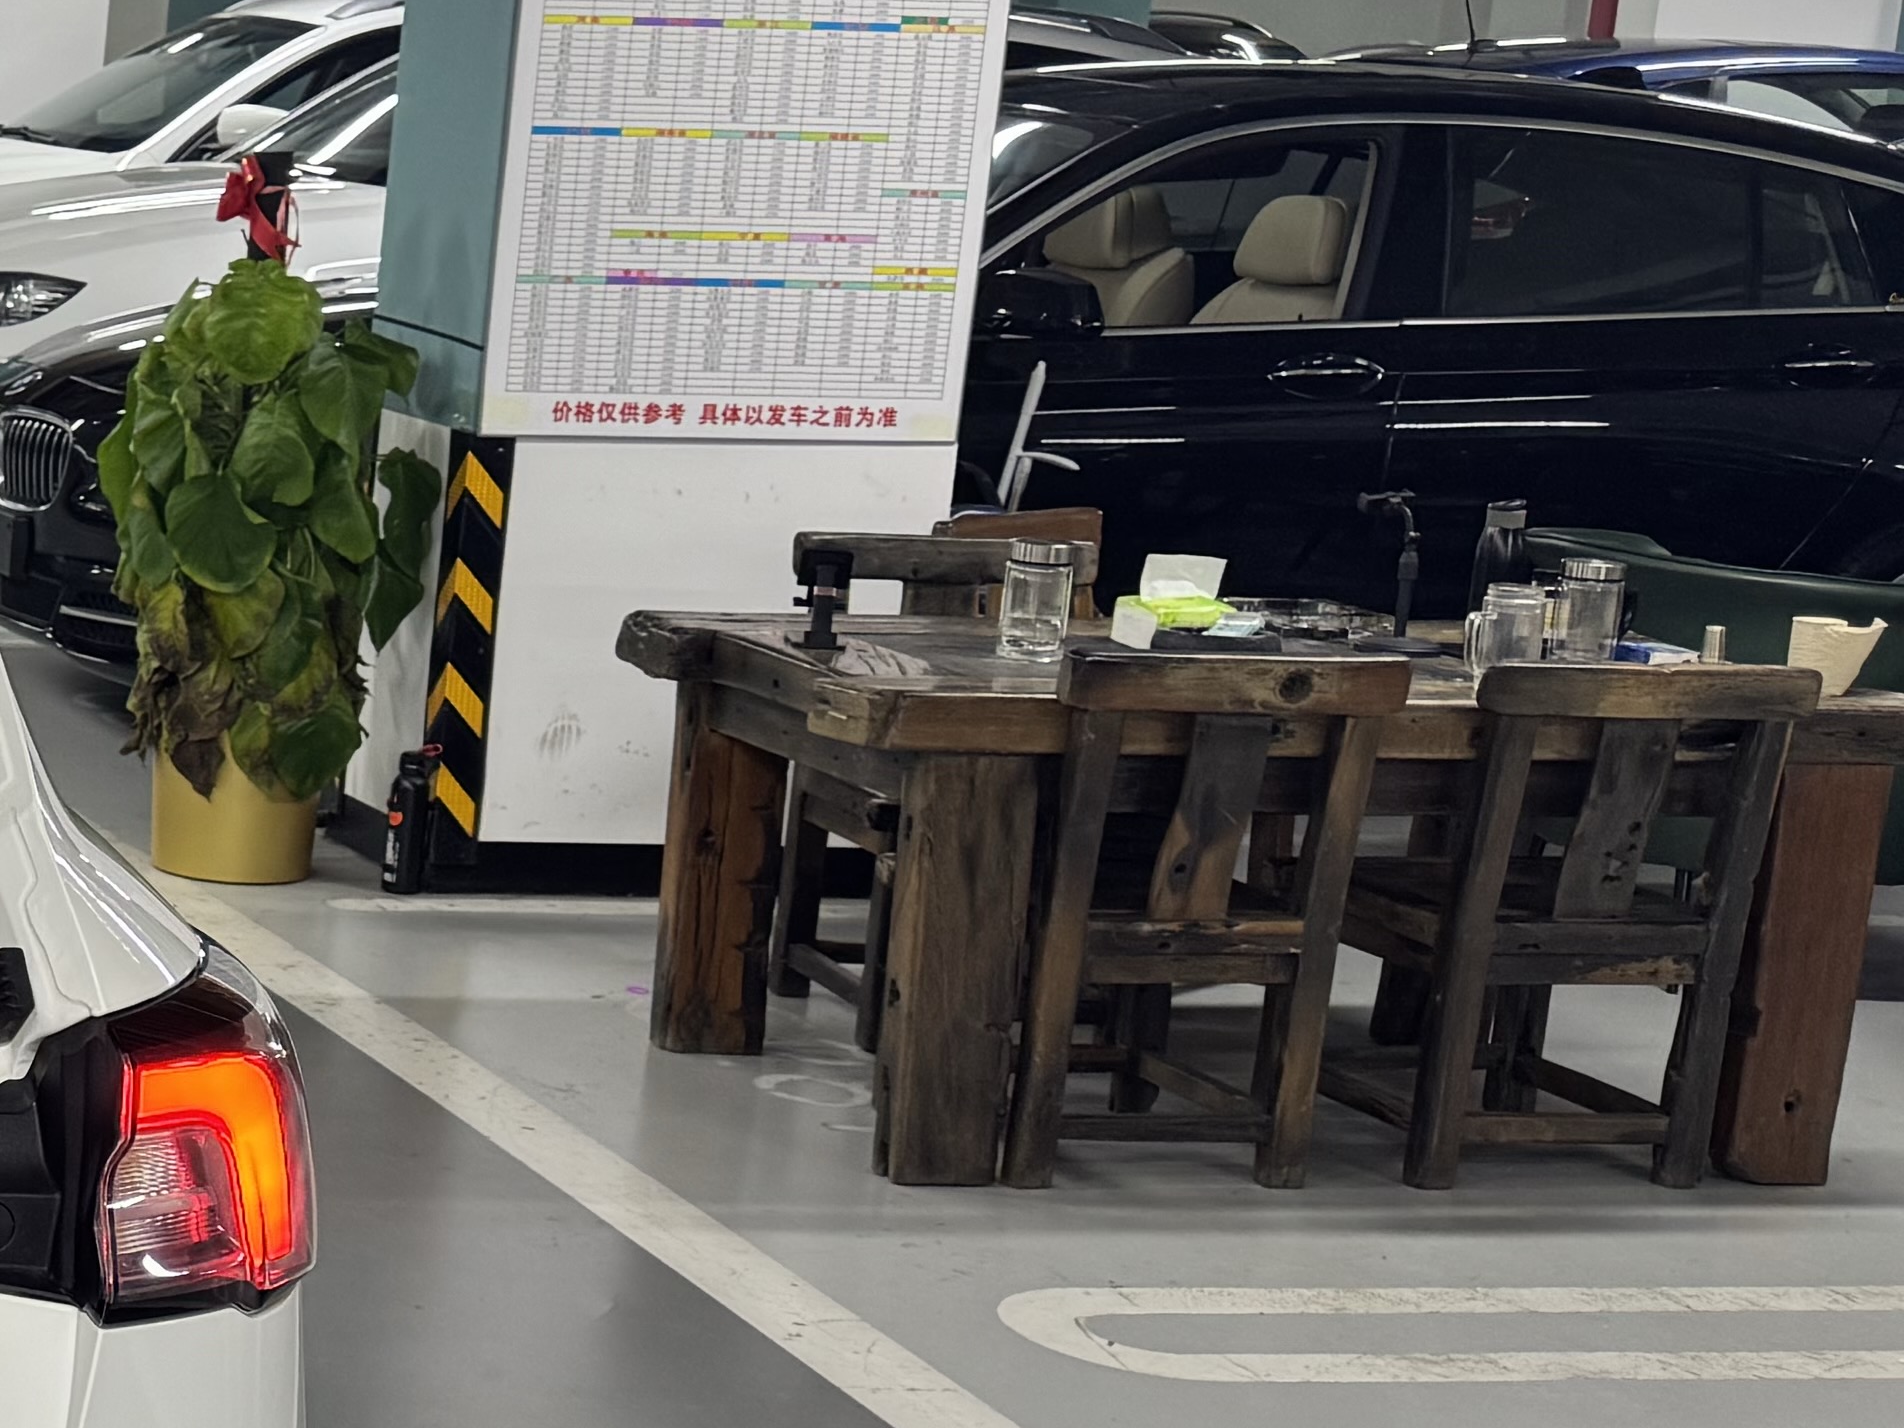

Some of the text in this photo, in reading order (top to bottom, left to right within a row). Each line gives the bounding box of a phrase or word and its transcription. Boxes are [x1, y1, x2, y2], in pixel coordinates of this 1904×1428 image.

[552, 401, 898, 429] 价格仅供参考 具体以发车之前为准
